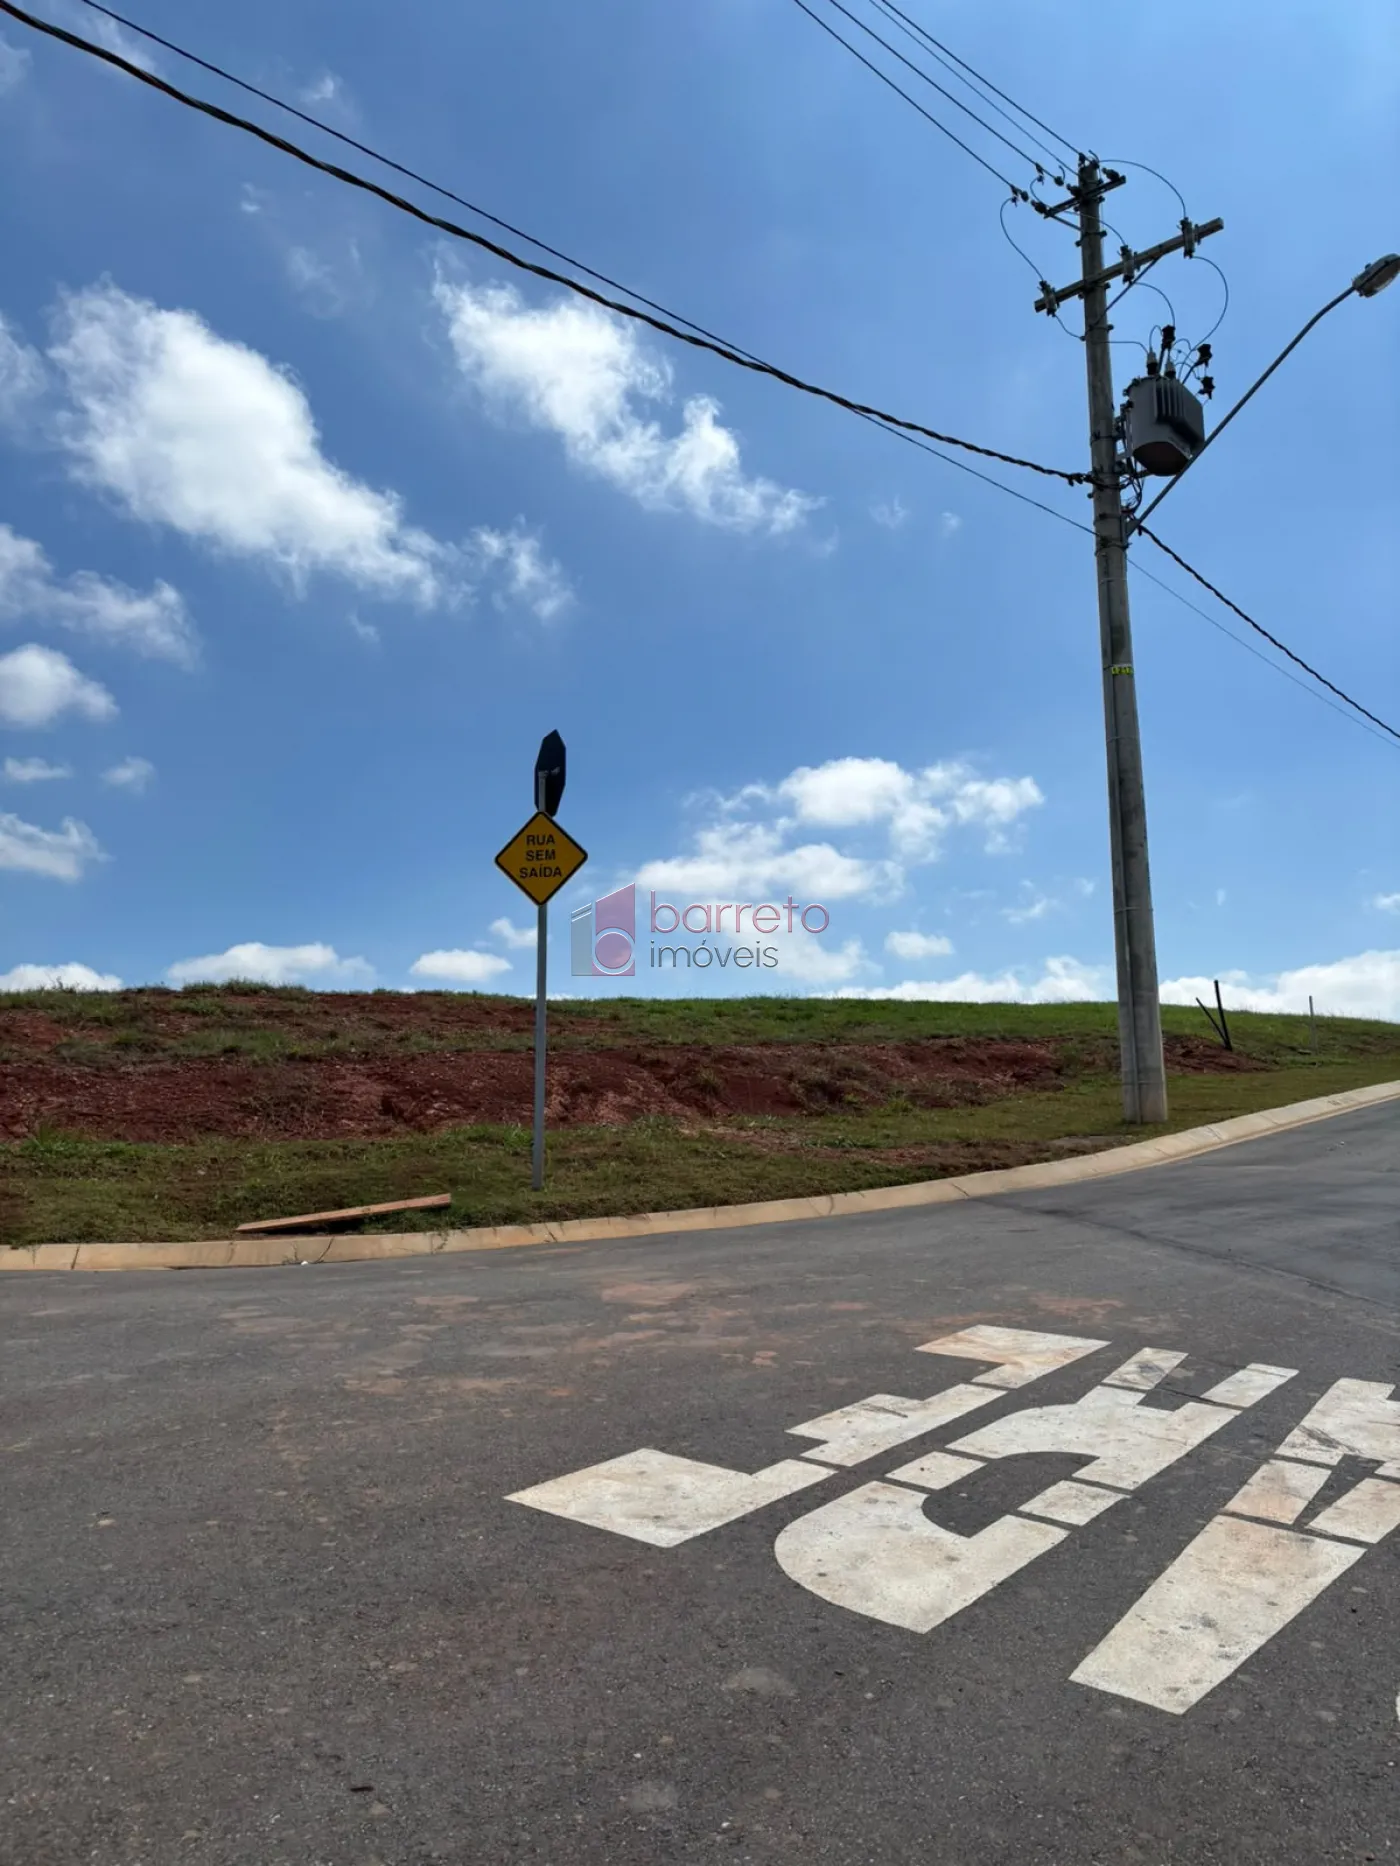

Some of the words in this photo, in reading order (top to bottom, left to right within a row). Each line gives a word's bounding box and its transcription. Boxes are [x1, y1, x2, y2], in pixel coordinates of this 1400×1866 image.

[526, 834, 556, 846] RUA
[525, 849, 556, 862] SEM
[519, 864, 562, 879] SAÍDA
